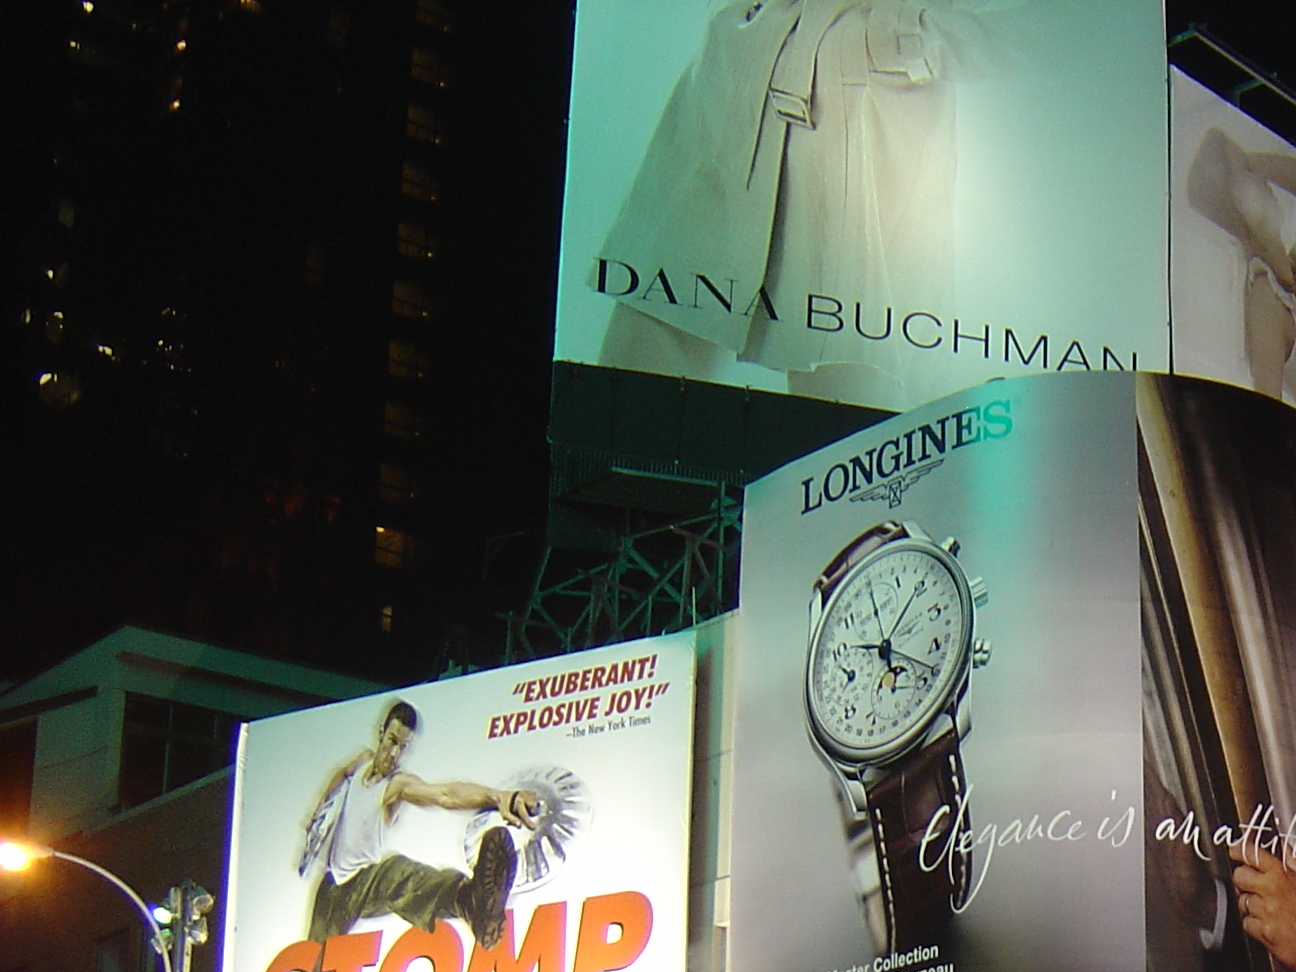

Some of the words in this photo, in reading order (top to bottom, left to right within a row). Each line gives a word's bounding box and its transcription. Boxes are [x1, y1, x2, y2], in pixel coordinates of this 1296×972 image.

[594, 257, 780, 322] DANA
[806, 293, 1139, 372] BUCHMAN
[801, 399, 1013, 515] LONGINES
[488, 696, 601, 740] EXPLOSIVE
[512, 653, 658, 703] "EXUBERANT!
[588, 723, 606, 734] New
[607, 717, 626, 731] York
[629, 715, 652, 728] Times
[919, 783, 1087, 914] Elegance
[1097, 790, 1136, 848] is
[1155, 811, 1211, 861] an
